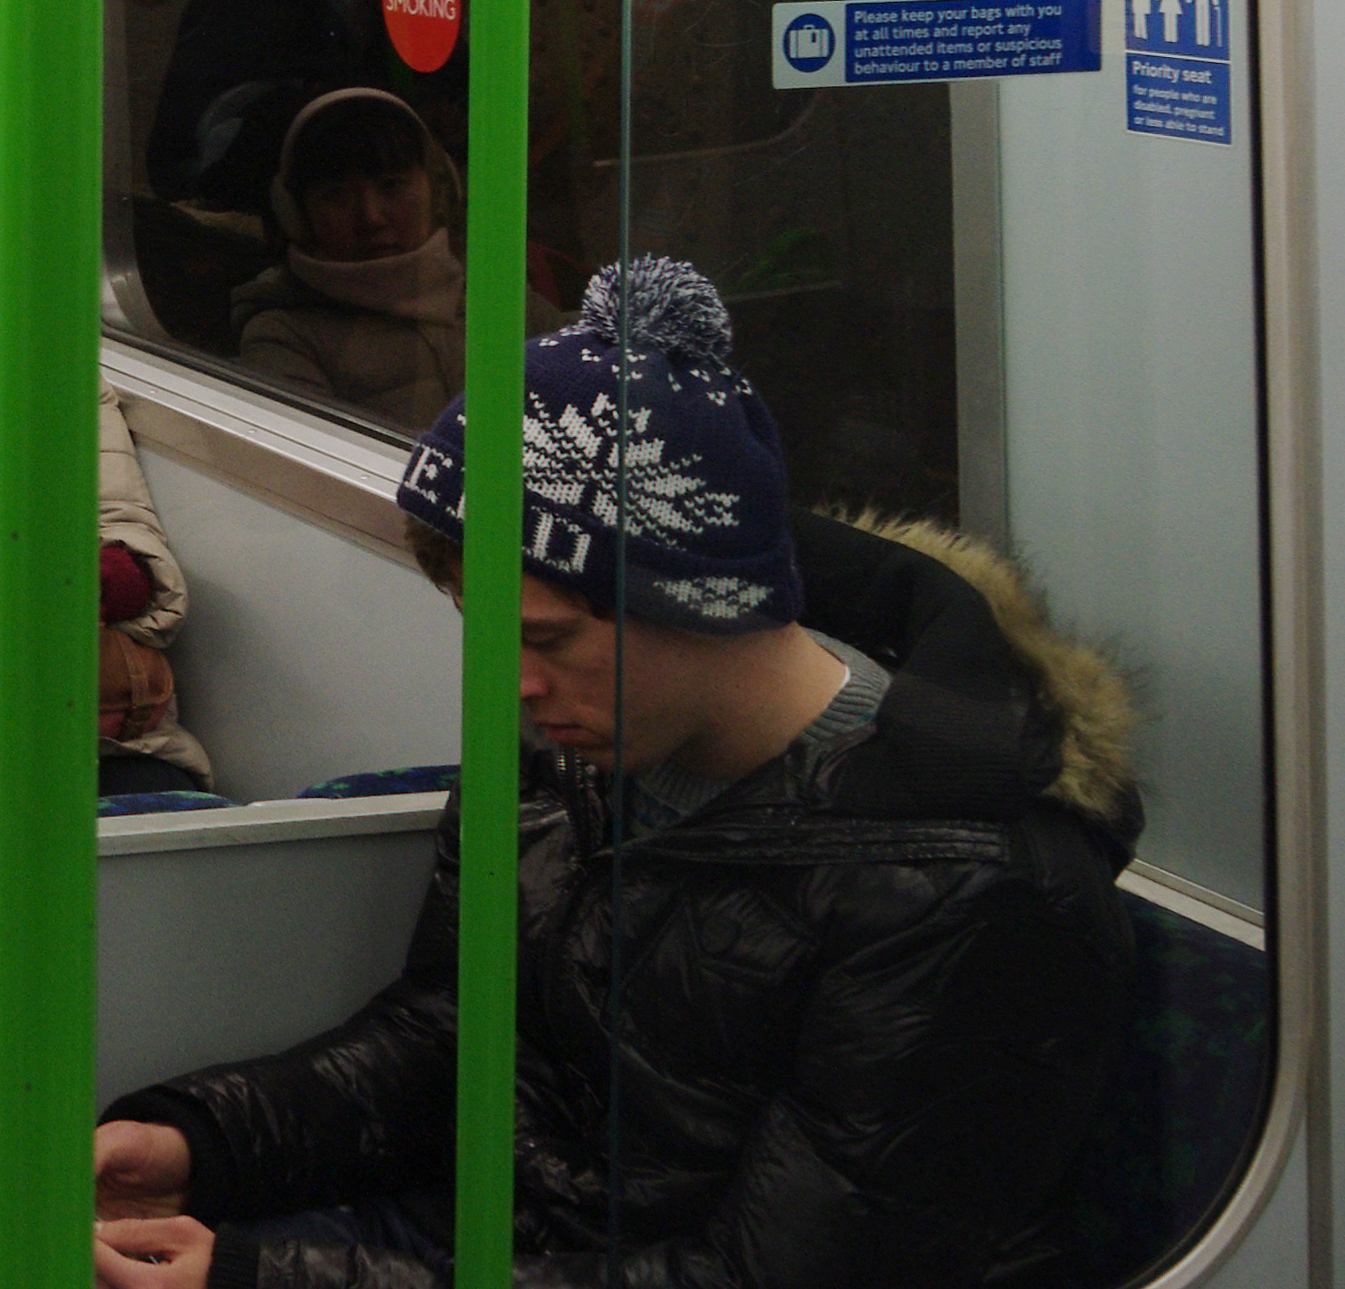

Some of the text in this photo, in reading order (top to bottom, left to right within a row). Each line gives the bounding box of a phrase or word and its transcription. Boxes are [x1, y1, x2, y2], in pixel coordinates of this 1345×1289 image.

[854, 5, 1062, 25] Please keep your bags with you
[854, 23, 1031, 41] at all times and report any
[854, 38, 1062, 58] unattended items or suspicious
[854, 52, 1062, 75] behaviour to a member of staff
[1132, 60, 1212, 84] Priority seat
